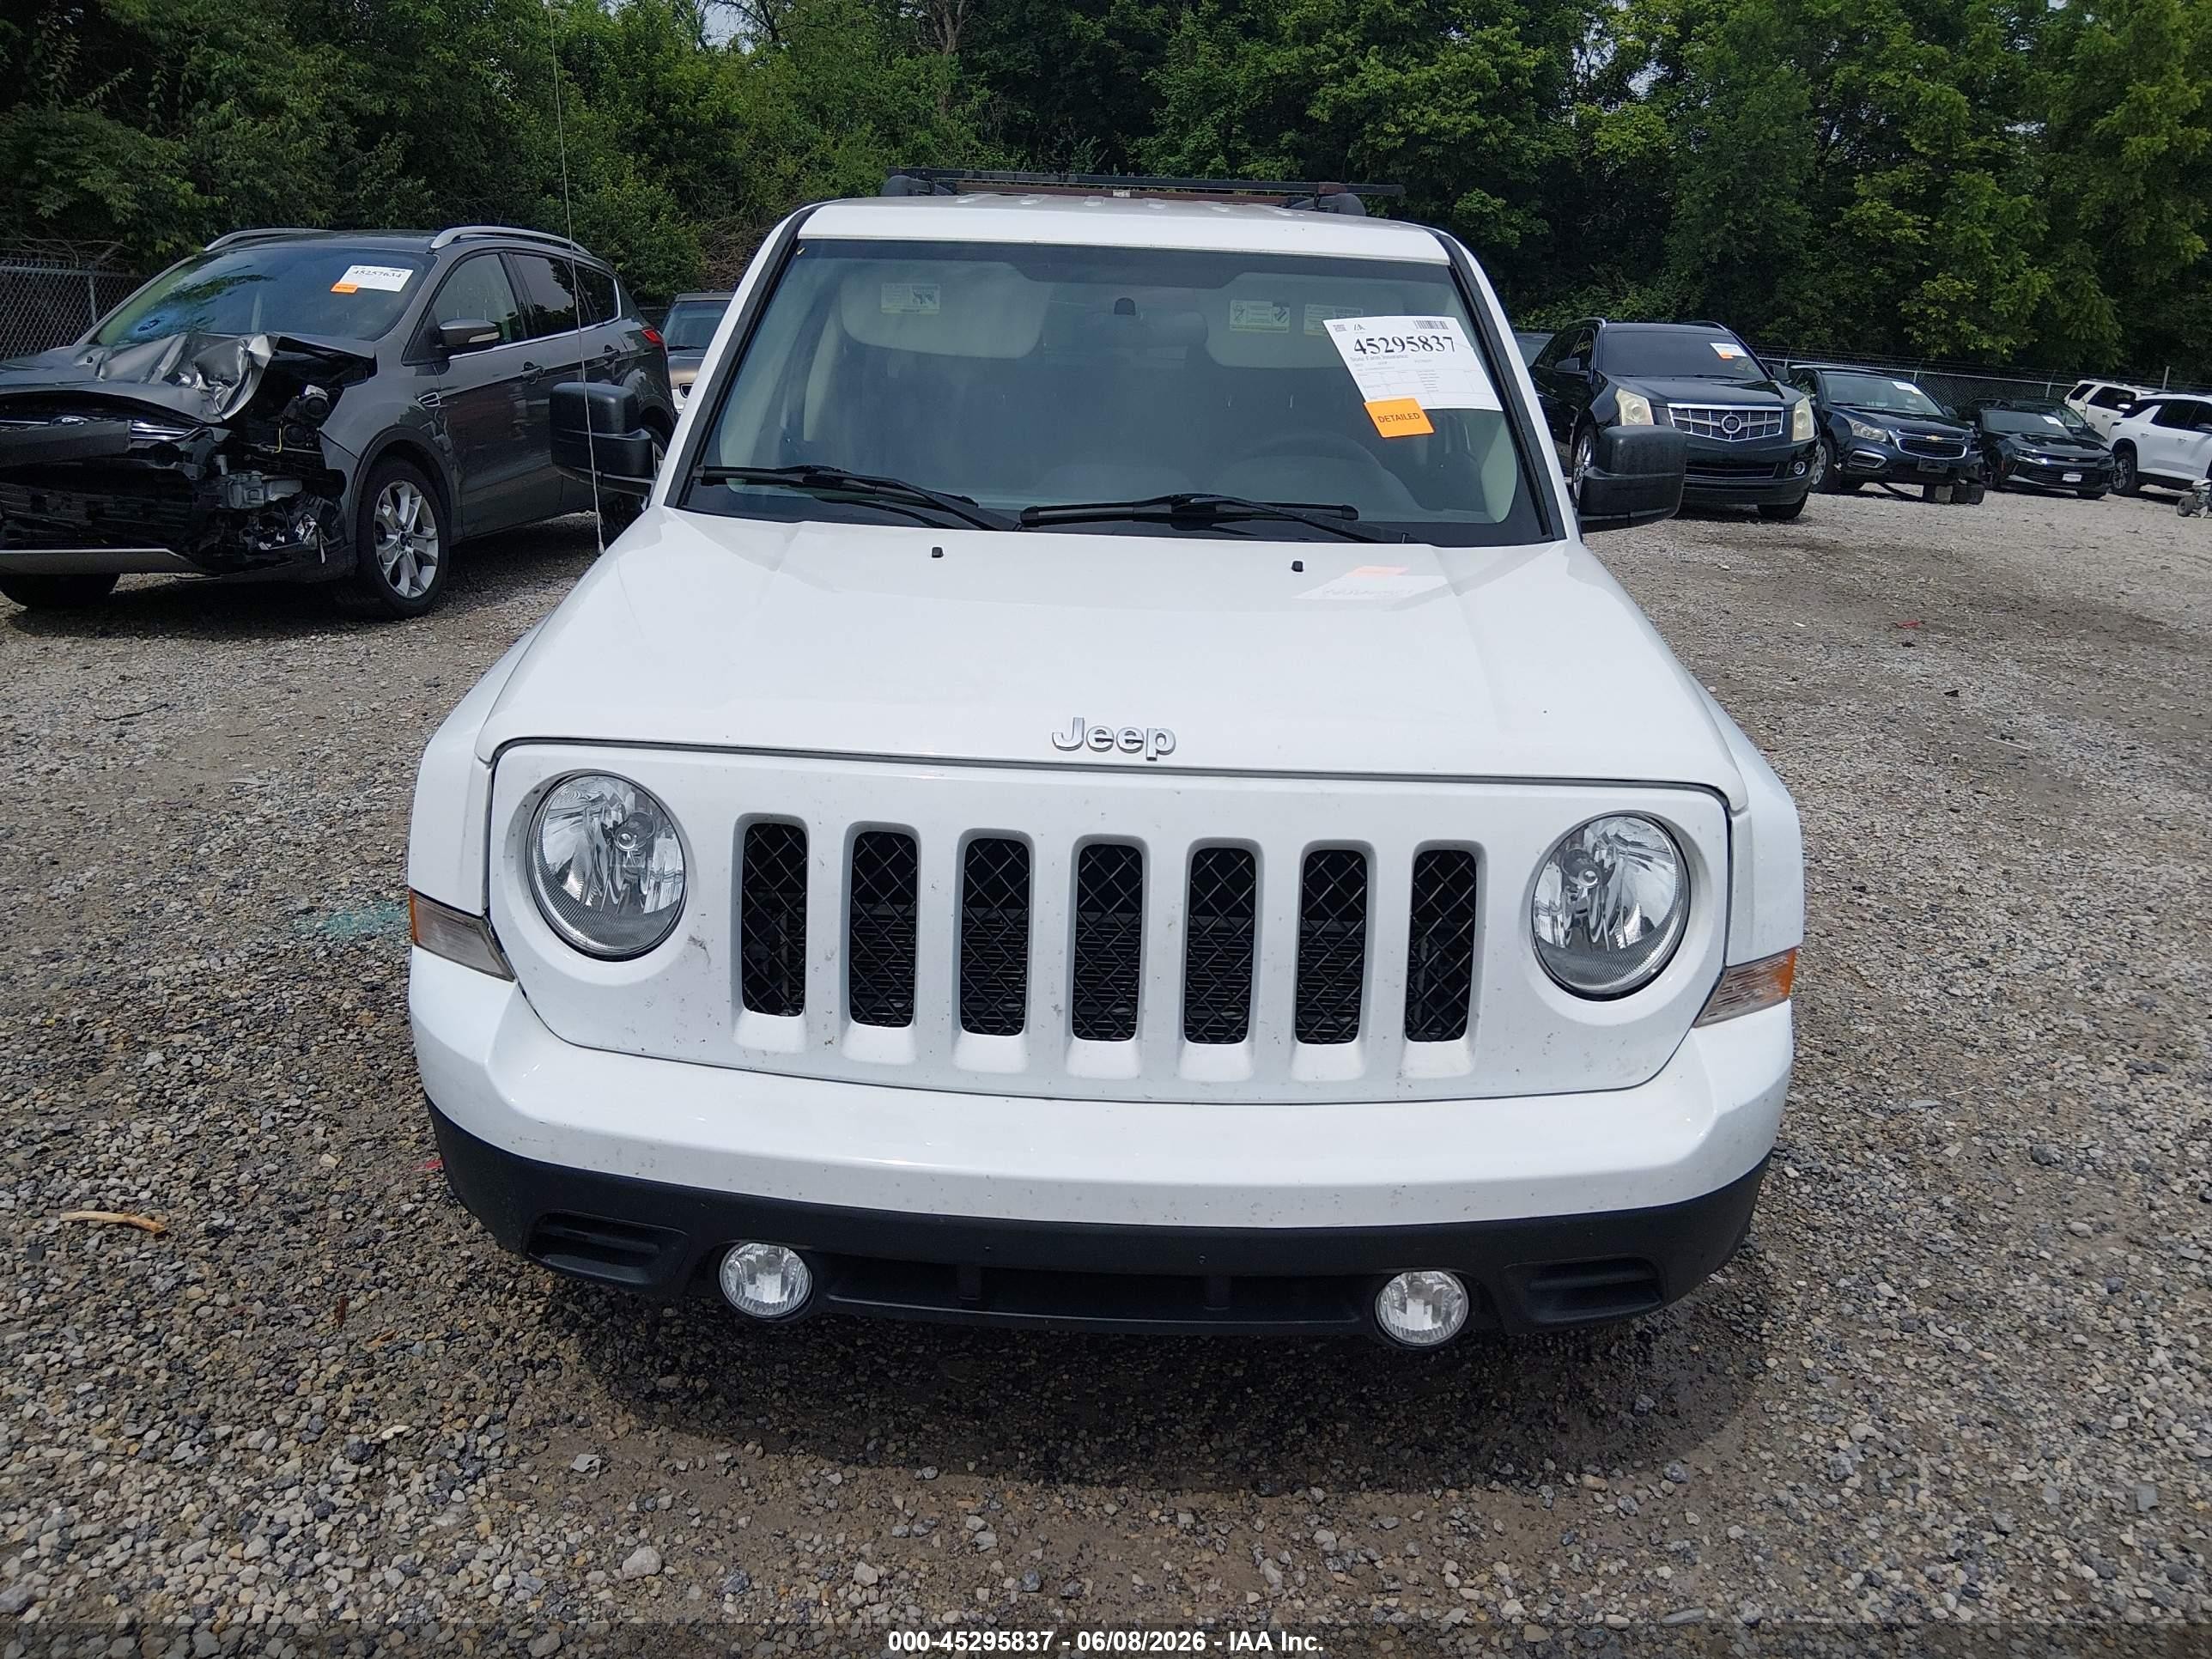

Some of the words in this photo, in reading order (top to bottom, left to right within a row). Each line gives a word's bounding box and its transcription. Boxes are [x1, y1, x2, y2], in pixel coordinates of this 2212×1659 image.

[1353, 335, 1455, 355] 45295837
[1377, 412, 1420, 423] DETAILED
[1052, 717, 1176, 761] Jeep
